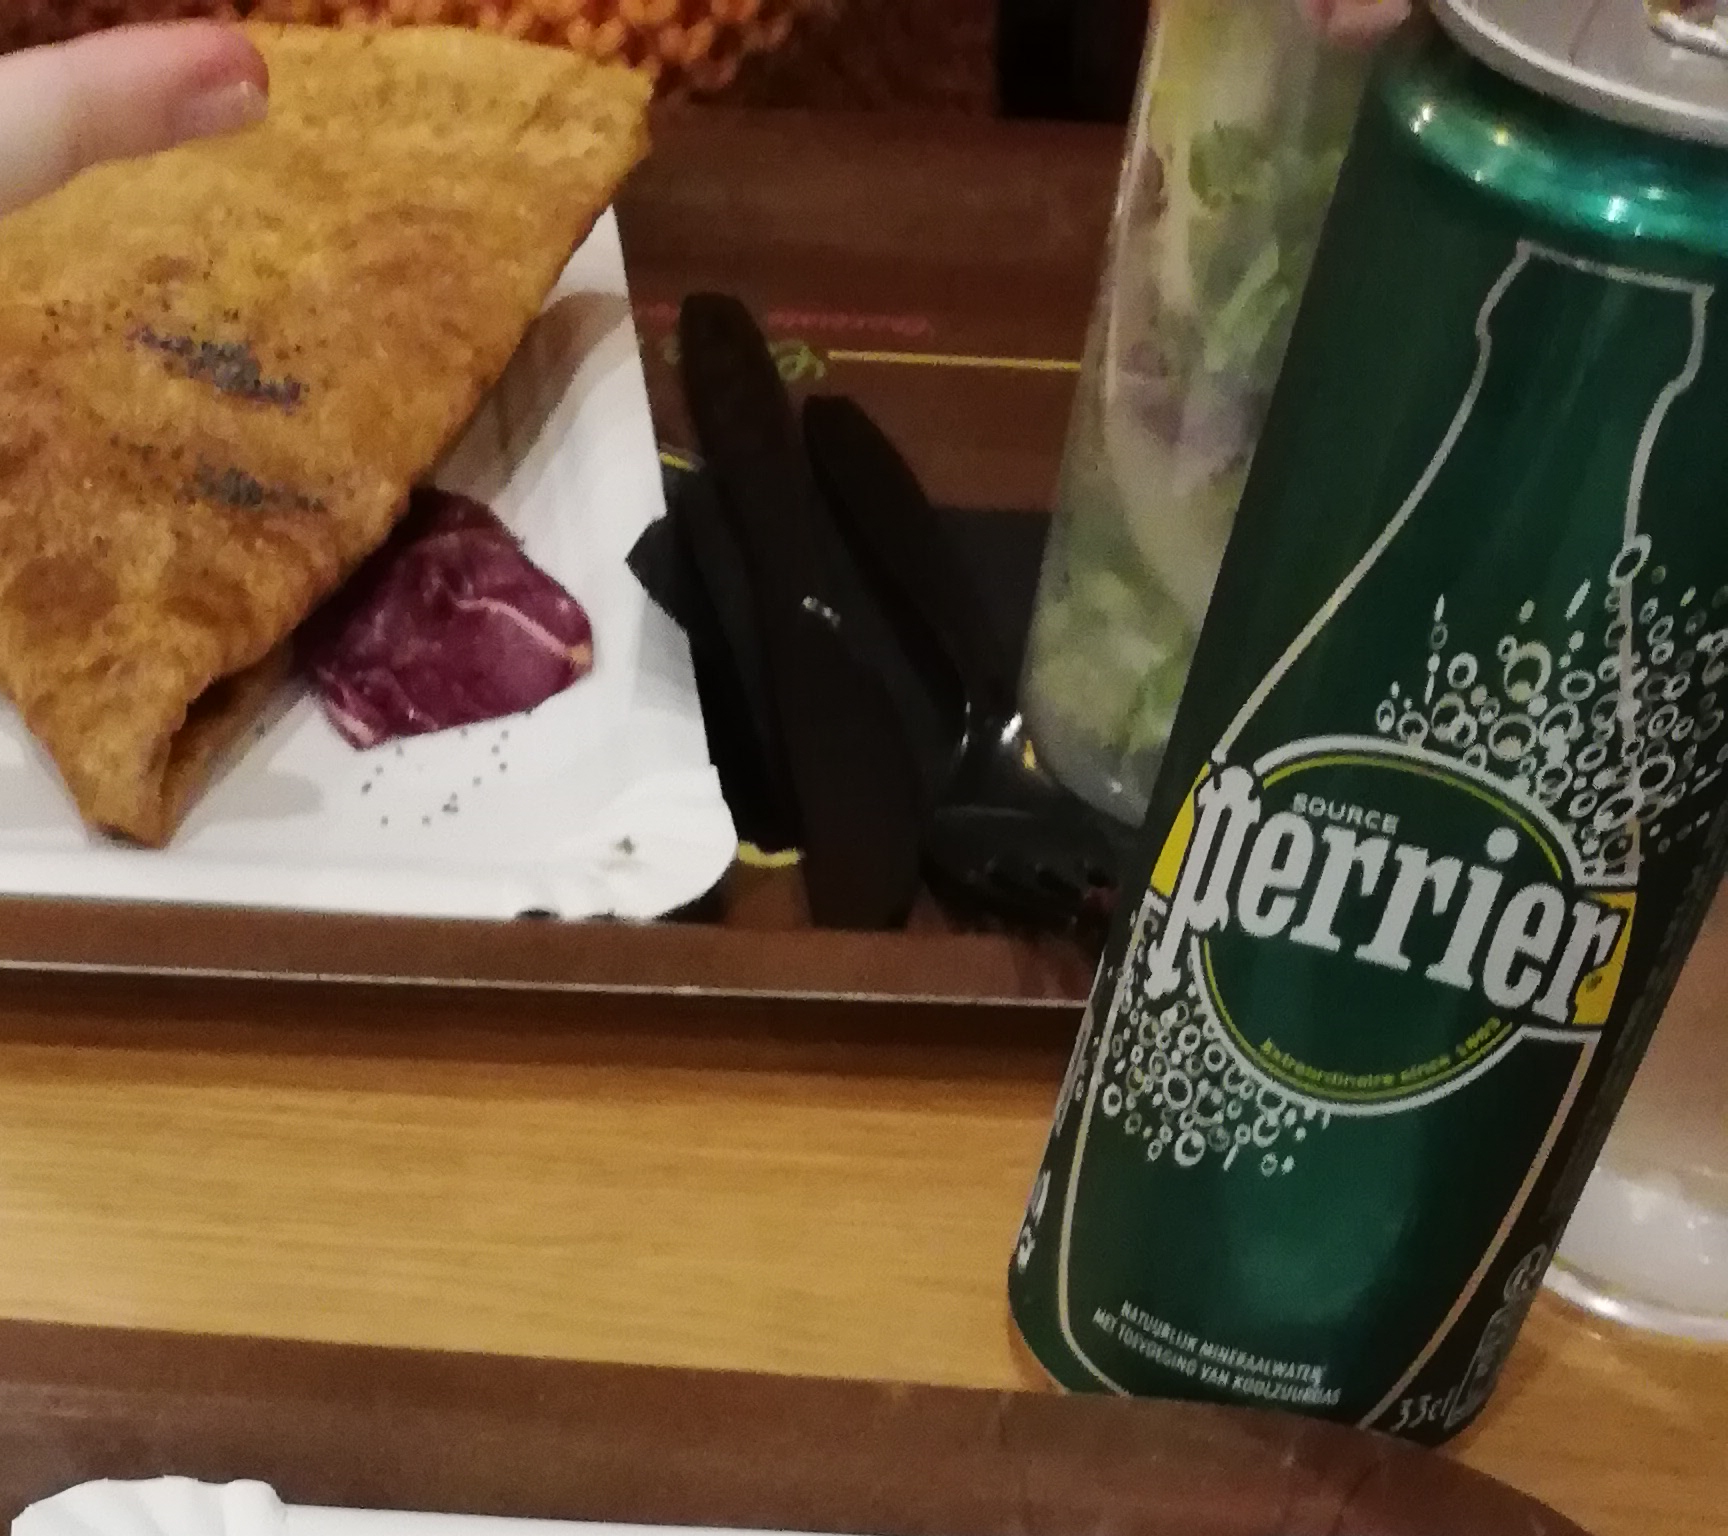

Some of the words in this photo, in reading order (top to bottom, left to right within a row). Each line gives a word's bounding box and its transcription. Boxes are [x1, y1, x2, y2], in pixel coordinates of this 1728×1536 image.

[1291, 791, 1401, 835] SOURCE
[1143, 765, 1622, 1024] perrier
[1199, 1362, 1231, 1388] VAN
